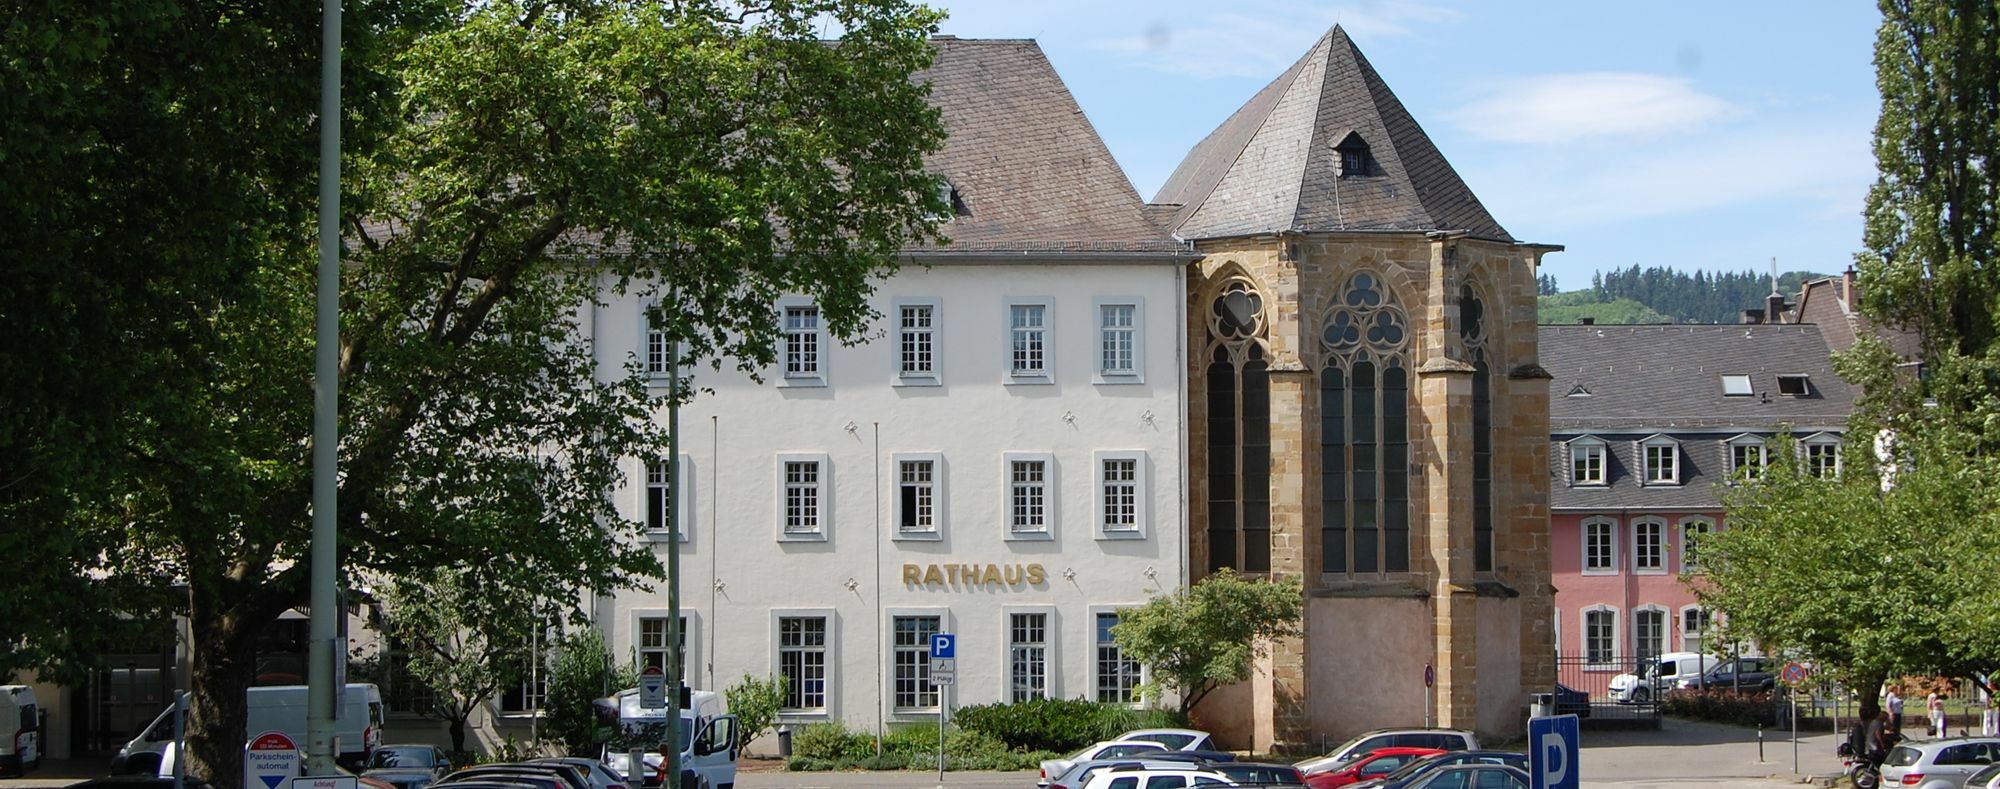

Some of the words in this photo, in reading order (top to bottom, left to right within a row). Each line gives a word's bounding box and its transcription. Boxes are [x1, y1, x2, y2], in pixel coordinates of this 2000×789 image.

[903, 563, 1046, 586] RATHAUS
[936, 637, 950, 656] P
[250, 752, 296, 761] Parkschein-
[1542, 732, 1567, 789] P
